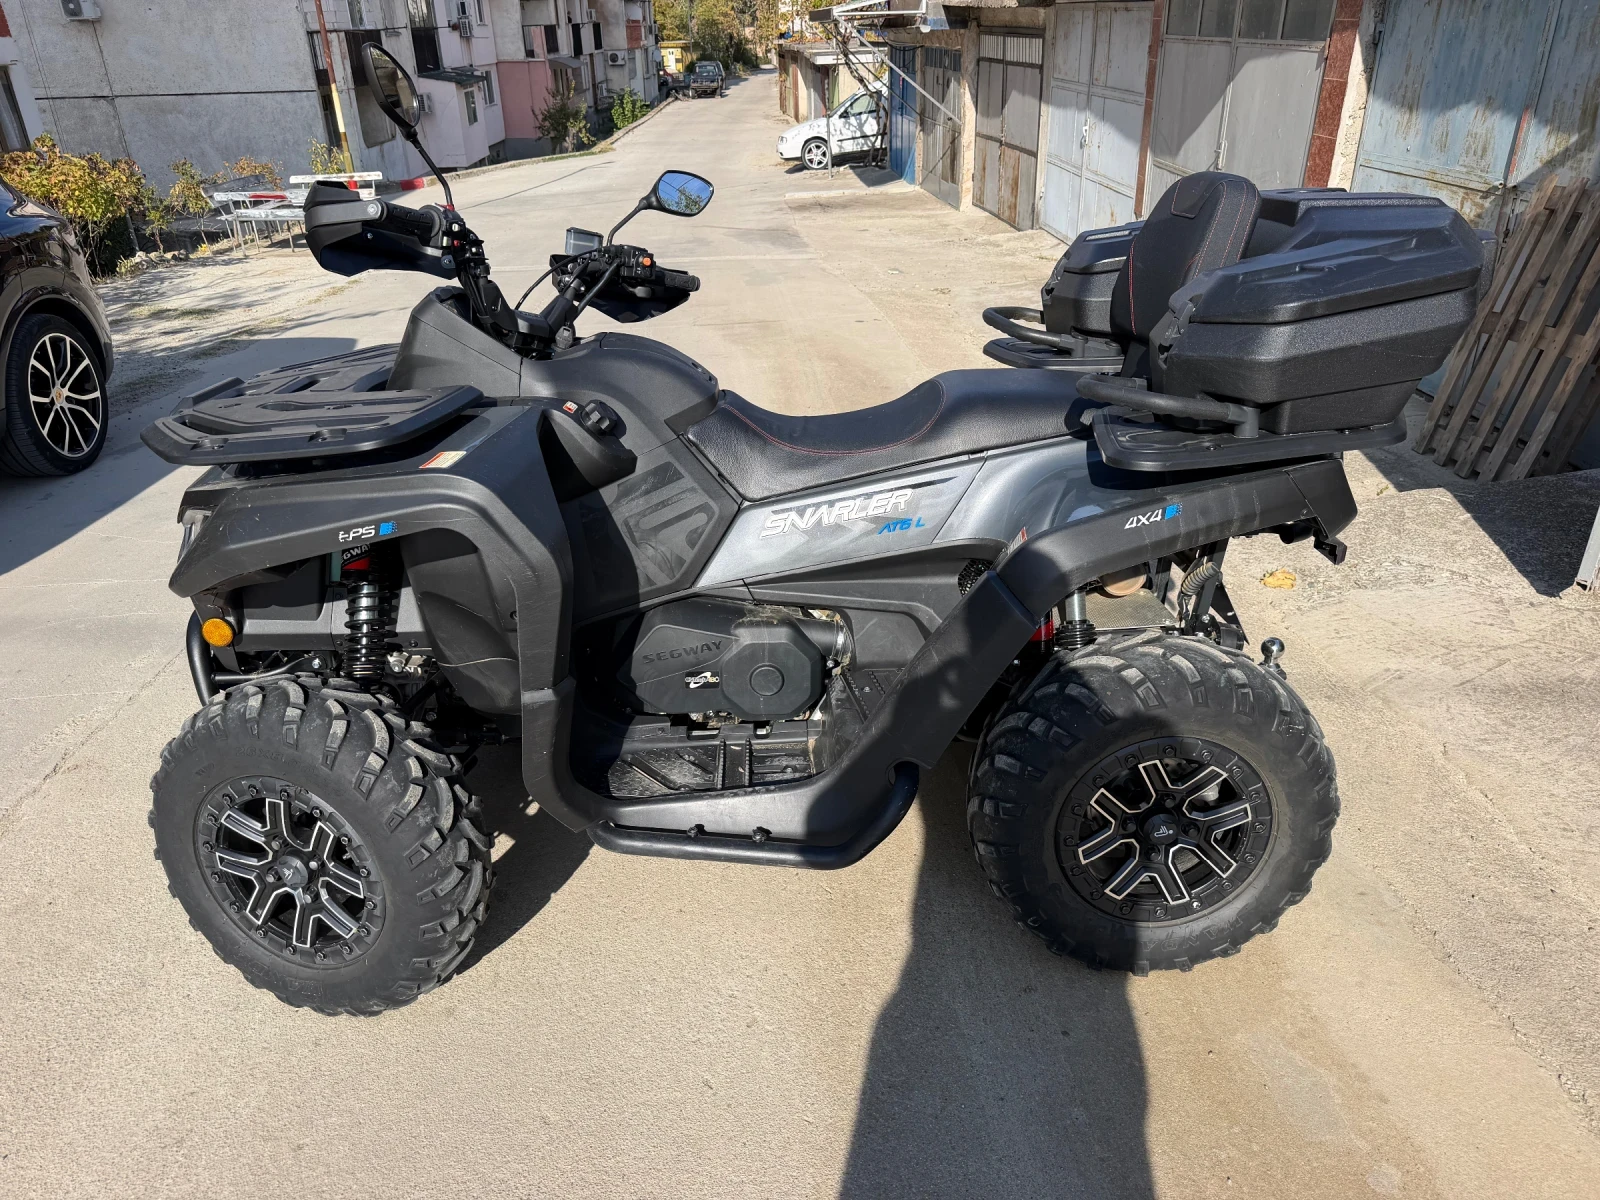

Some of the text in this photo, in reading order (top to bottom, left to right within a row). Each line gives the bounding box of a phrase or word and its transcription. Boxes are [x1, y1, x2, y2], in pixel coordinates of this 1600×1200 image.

[760, 489, 913, 538] SNARLER
[877, 516, 926, 535] AT6 L
[642, 640, 722, 664] SEGWAY
